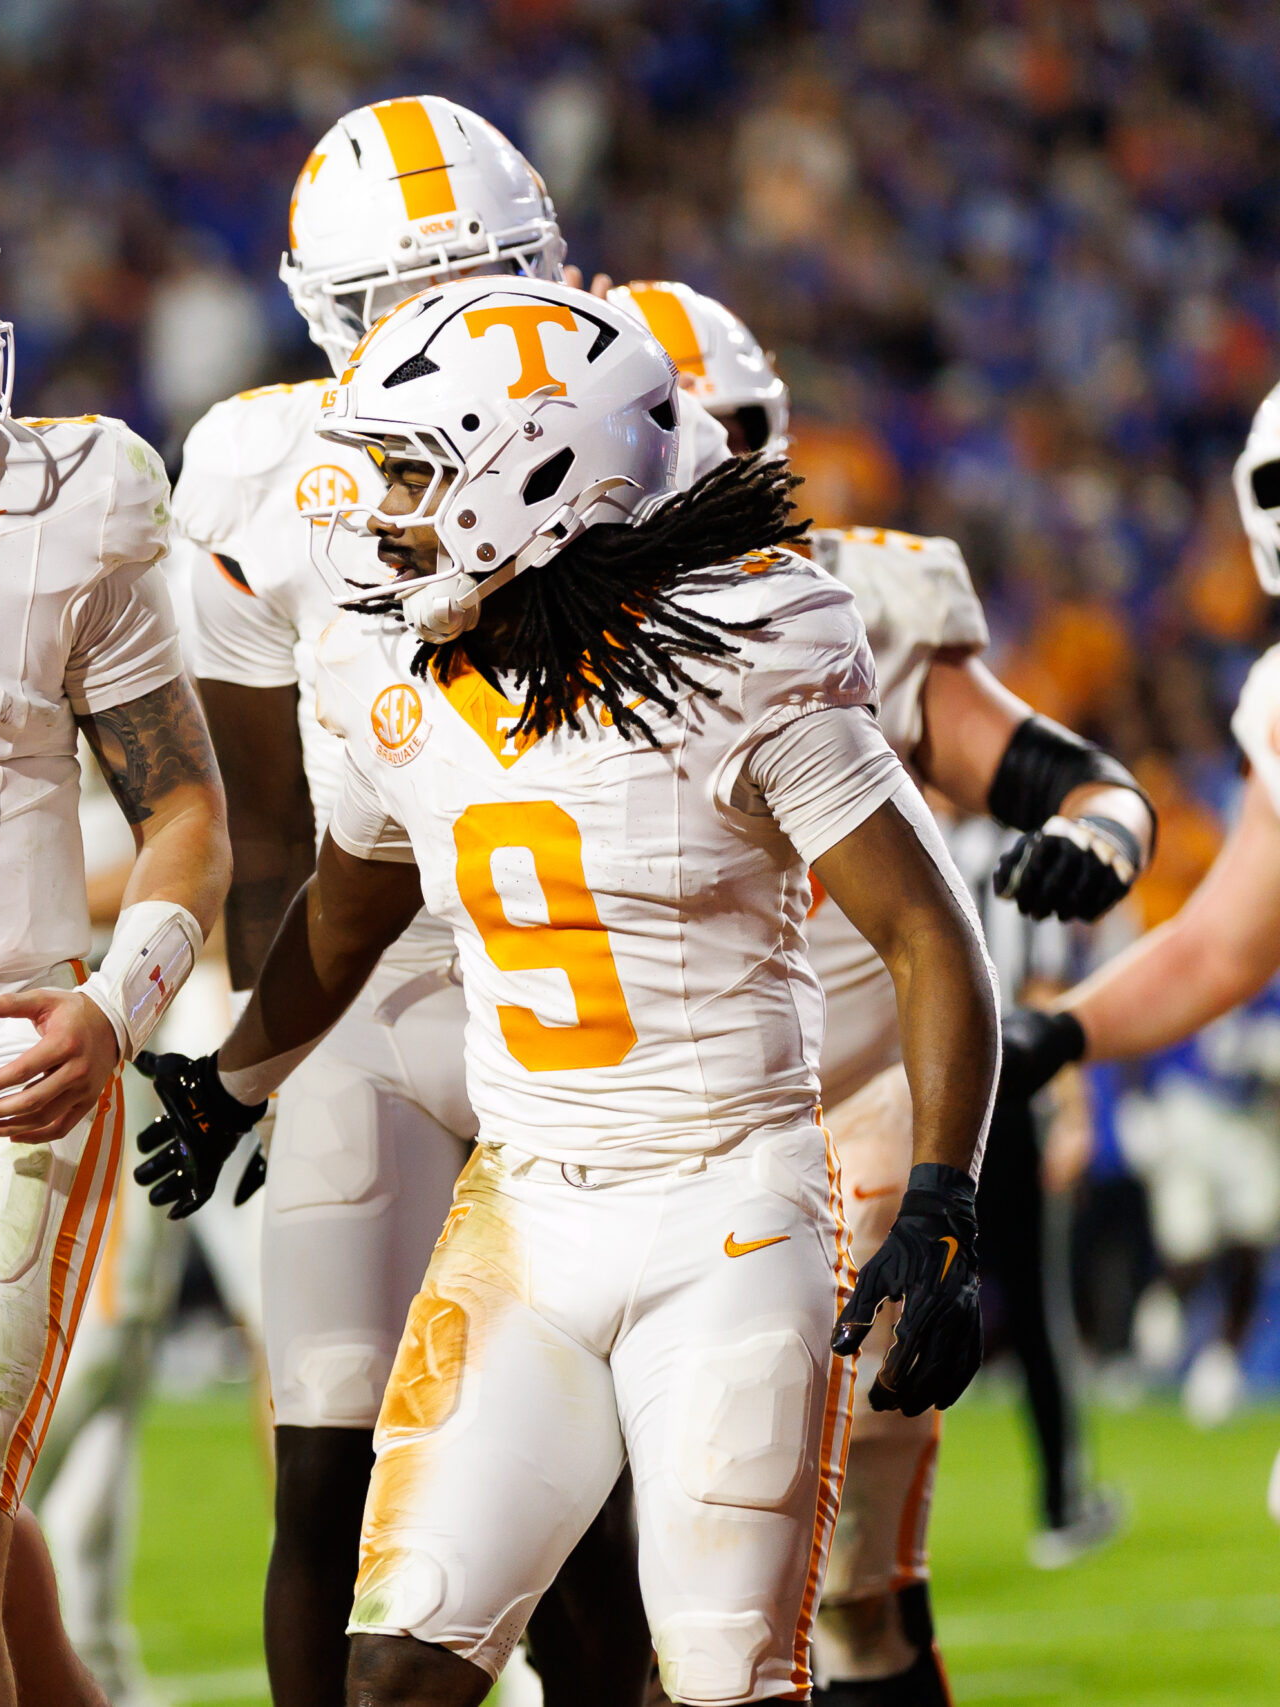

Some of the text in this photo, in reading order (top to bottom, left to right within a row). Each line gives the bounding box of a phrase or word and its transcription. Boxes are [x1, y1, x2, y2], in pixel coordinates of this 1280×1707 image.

[419, 219, 455, 235] VOLS
[462, 305, 579, 400] T
[374, 688, 417, 744] SEC
[375, 735, 423, 764] GRADUATE
[452, 800, 639, 1073] 9
